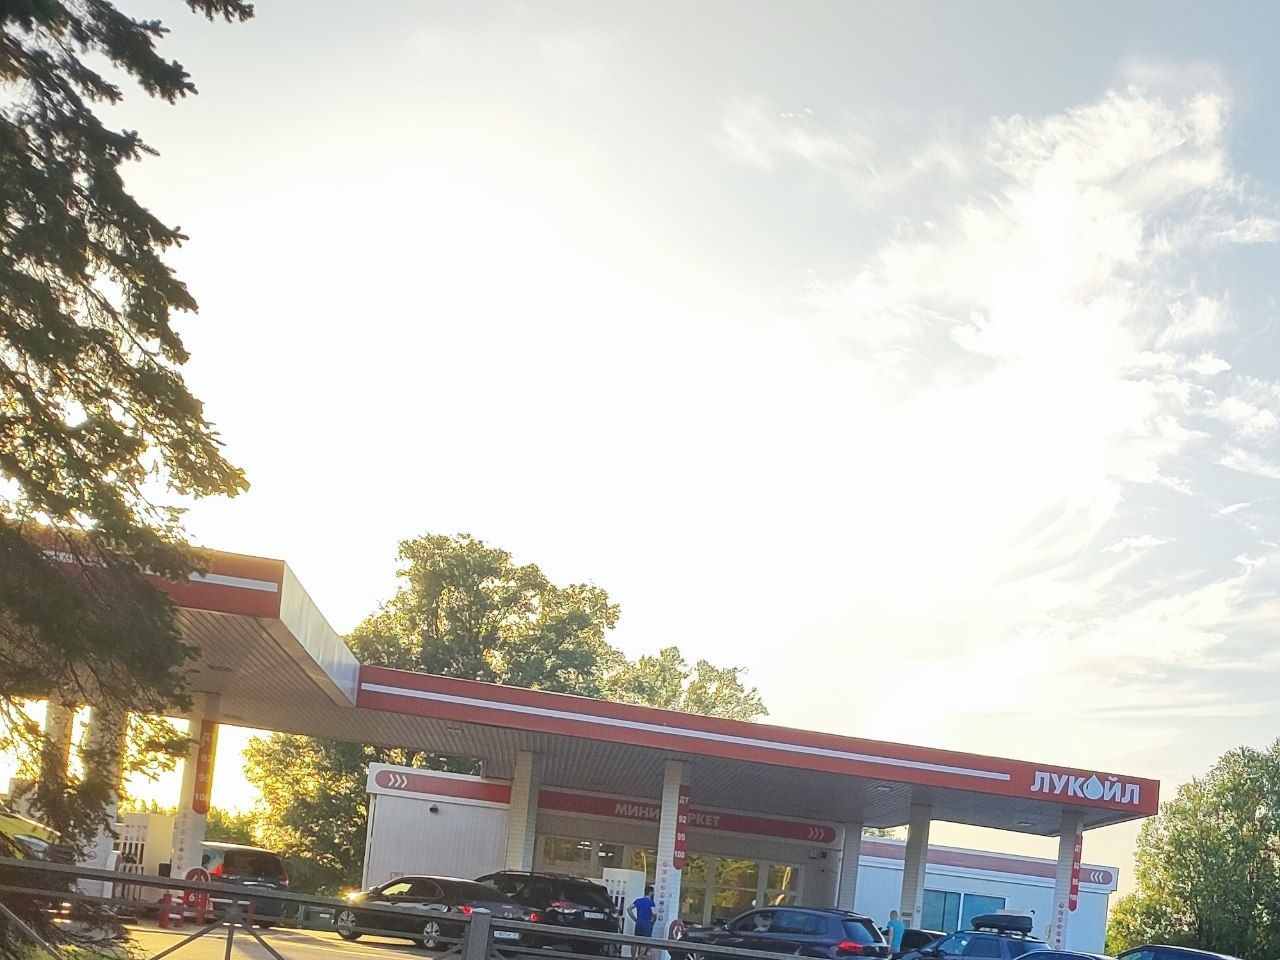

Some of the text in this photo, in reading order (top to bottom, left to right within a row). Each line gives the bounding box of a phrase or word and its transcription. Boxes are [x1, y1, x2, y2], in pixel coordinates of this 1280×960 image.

[1030, 771, 1140, 805] ЛУКОЙЛ
[679, 795, 690, 805] ДТ
[614, 803, 721, 827] МИНИРКЕТ
[678, 815, 688, 824] 92
[676, 832, 686, 842] 95
[674, 850, 686, 859] 100
